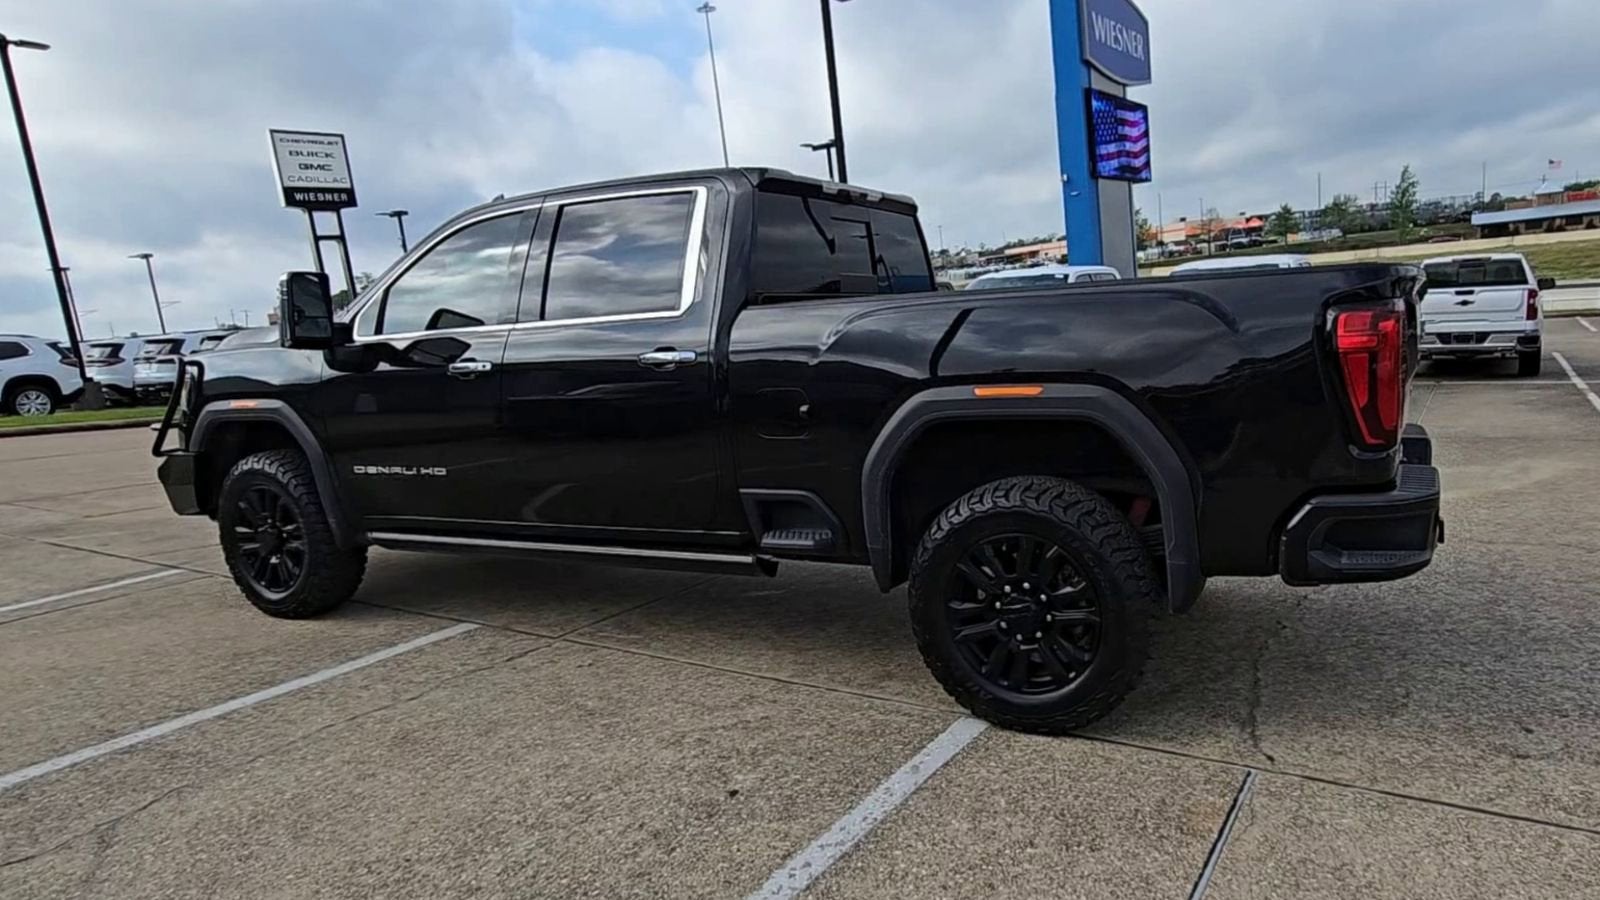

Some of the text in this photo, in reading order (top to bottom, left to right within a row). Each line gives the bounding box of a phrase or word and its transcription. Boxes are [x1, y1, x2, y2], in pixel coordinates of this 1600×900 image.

[1092, 11, 1145, 61] WIESNER
[279, 137, 339, 146] CHEVROLET
[288, 150, 336, 159] BUICK
[298, 163, 333, 171] GMC
[287, 175, 348, 184] CADILLAC
[295, 192, 348, 202] WIESNER
[353, 465, 447, 475] DENALI HD
